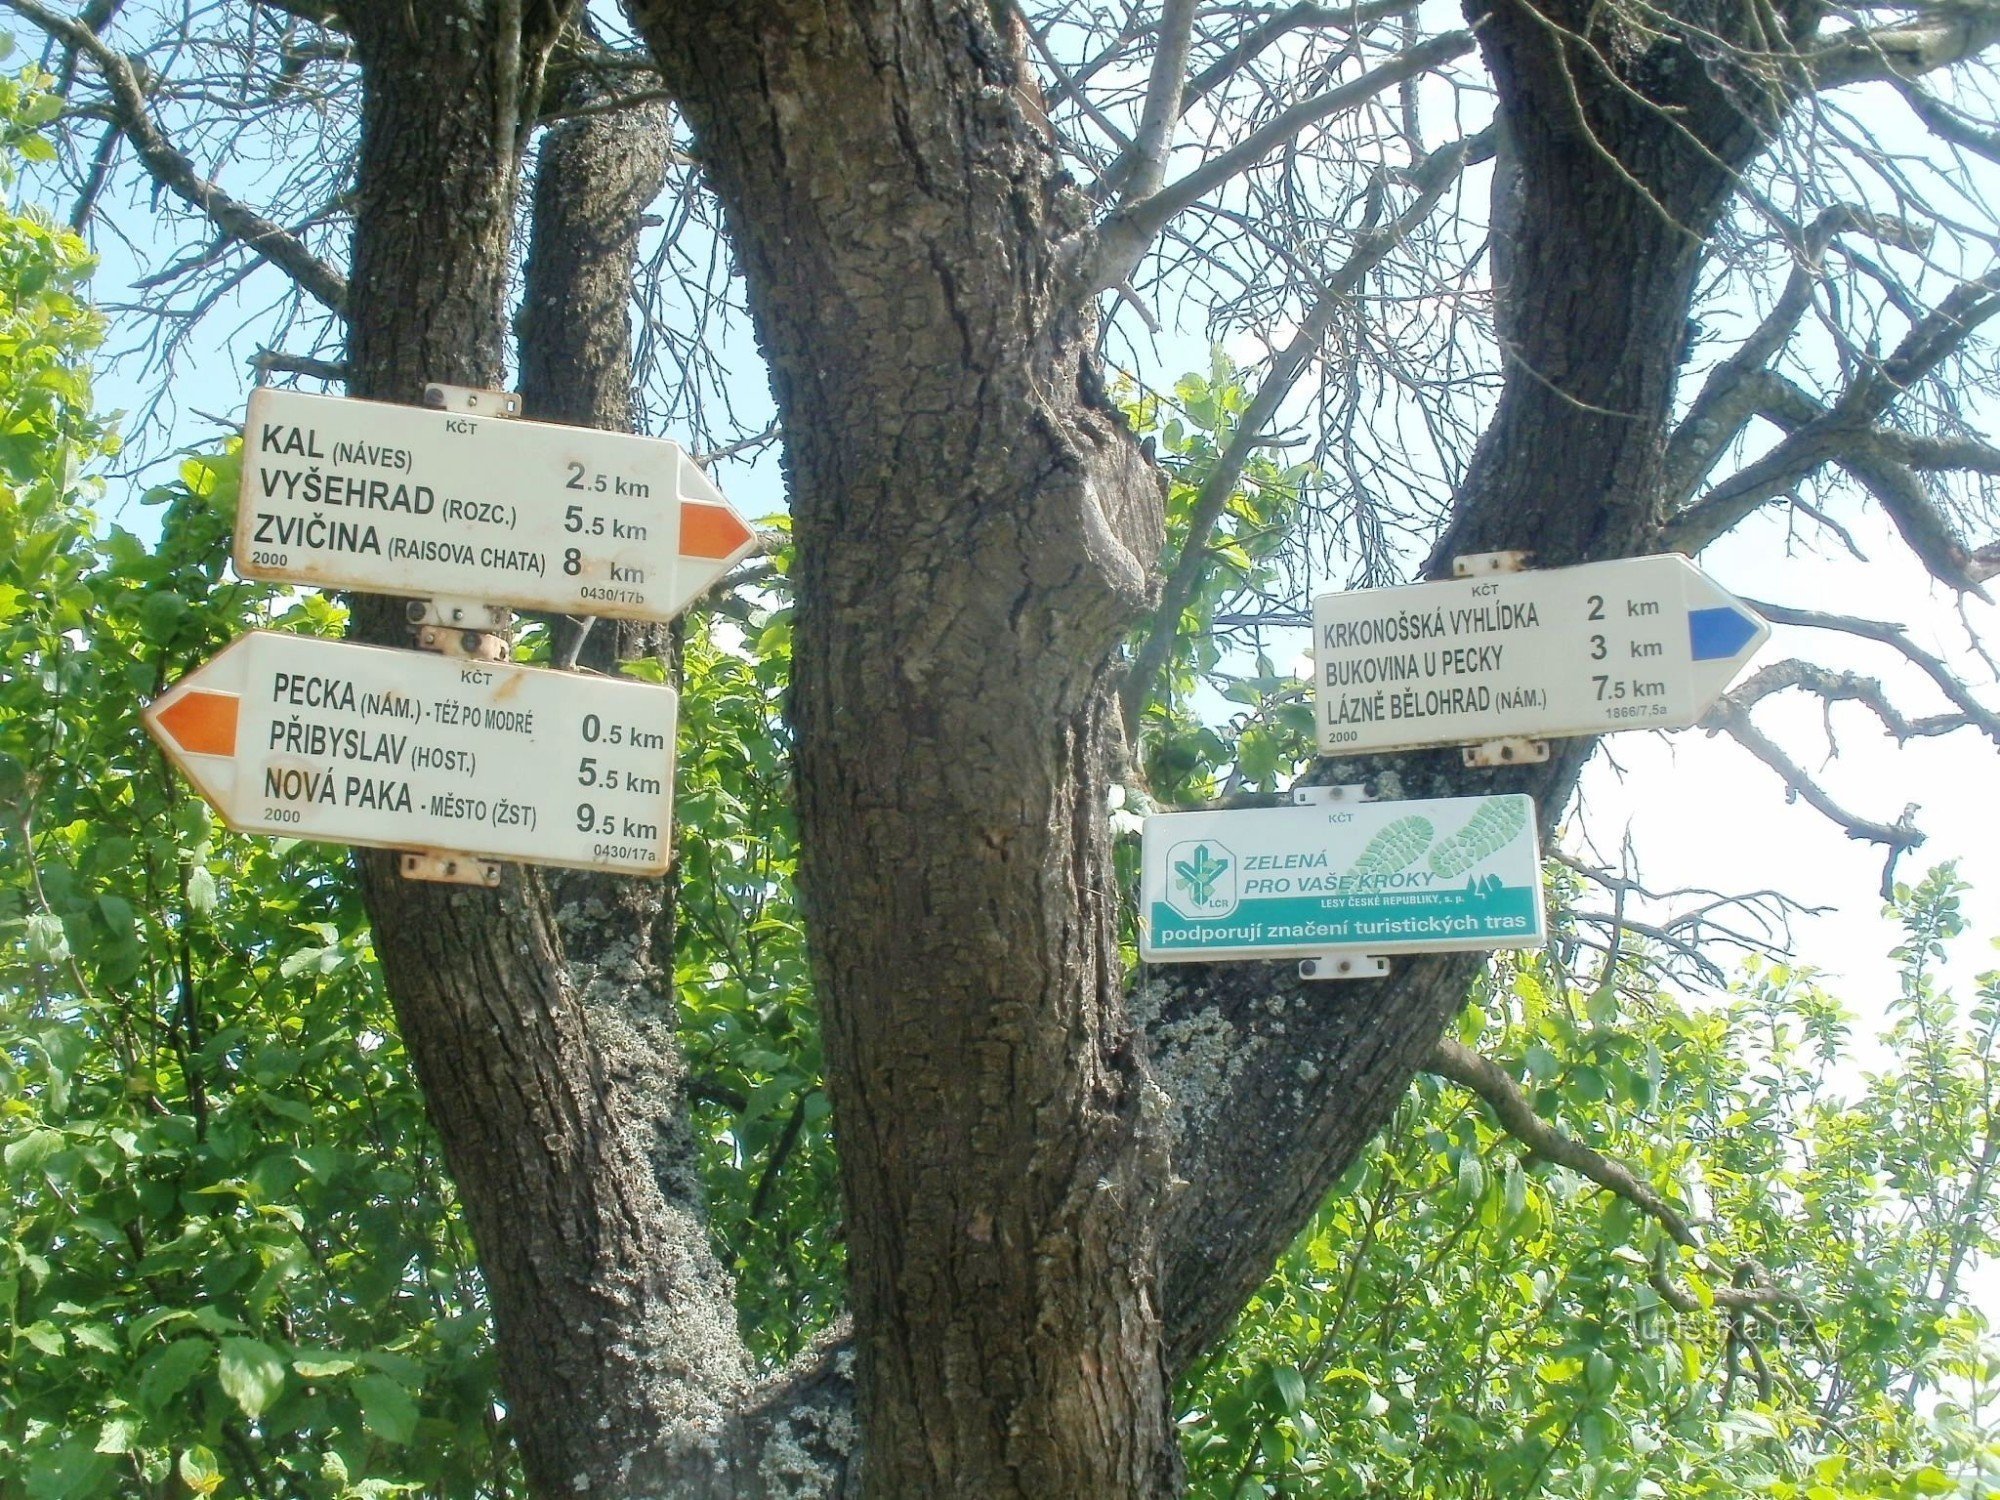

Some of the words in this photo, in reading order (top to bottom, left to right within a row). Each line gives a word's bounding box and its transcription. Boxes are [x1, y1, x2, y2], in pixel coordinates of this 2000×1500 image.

[446, 419, 478, 435] KČT
[262, 424, 324, 458] KAL
[333, 441, 412, 474] (NÁVES)
[566, 462, 607, 493] 2.5
[616, 477, 649, 498] km
[261, 466, 434, 514] VYŠEHRAD
[443, 499, 516, 530] (ROZC.)
[564, 505, 604, 536] 5.5
[613, 519, 647, 541] km
[254, 512, 381, 555] ZVIČINA
[388, 537, 474, 565] (RAISOVA
[481, 548, 545, 578] CHATA)
[563, 548, 582, 576] 8
[610, 562, 644, 584] km
[252, 552, 288, 567] 2000
[580, 586, 644, 604] 0430/17b
[1472, 584, 1499, 597] KČT
[1324, 606, 1445, 648] KRKONOŠSKÁ
[1450, 600, 1539, 634] VYHLÍDKA
[1587, 595, 1604, 620] 2
[1627, 600, 1659, 616] km
[1327, 654, 1419, 686] BUKOVINA
[1424, 652, 1436, 677] U
[1443, 645, 1503, 675] PECKY
[1590, 634, 1607, 660] 3
[1630, 641, 1662, 658] km
[461, 670, 493, 686] KČT
[1328, 690, 1384, 725] LÁZNĚ
[1391, 686, 1490, 719] BĚLOHRAD
[1496, 688, 1546, 714] (NÁM.)
[1592, 675, 1625, 700] 7.5
[1633, 680, 1665, 697] km
[274, 673, 356, 712] PECKA
[361, 691, 421, 725] (NÁM.)
[434, 699, 458, 725] TÉŽ
[462, 706, 481, 727] PO
[485, 709, 533, 734] MODRÉ
[582, 714, 622, 744] 0.5
[630, 727, 664, 750] km
[1329, 731, 1357, 743] 2000
[270, 715, 407, 765] PŘIBYSLAV
[411, 746, 476, 778] (HOST.)
[578, 757, 618, 789] 5.5
[626, 772, 660, 795] km
[265, 767, 336, 805] NOVÁ
[345, 776, 412, 813] PAKA
[430, 792, 486, 821] MĚSTO
[492, 798, 537, 832] (ŽST)
[576, 803, 615, 835] 9.5
[623, 817, 657, 840] km
[264, 808, 300, 823] 2000
[1329, 814, 1353, 823] KČT
[594, 844, 656, 862] 0430/17a
[1244, 849, 1328, 870] ZELENÁ
[1244, 878, 1290, 894] PRO
[1298, 873, 1354, 891] VAŠE
[1358, 872, 1434, 889] KROKY
[1321, 900, 1345, 908] LESY
[1348, 896, 1380, 907] ČESKÉ
[1383, 895, 1442, 905] REPUBLIKY,
[1162, 923, 1262, 943] podporují
[1267, 920, 1348, 938] značení
[1354, 915, 1478, 934] turistických
[1484, 915, 1526, 929] tras
